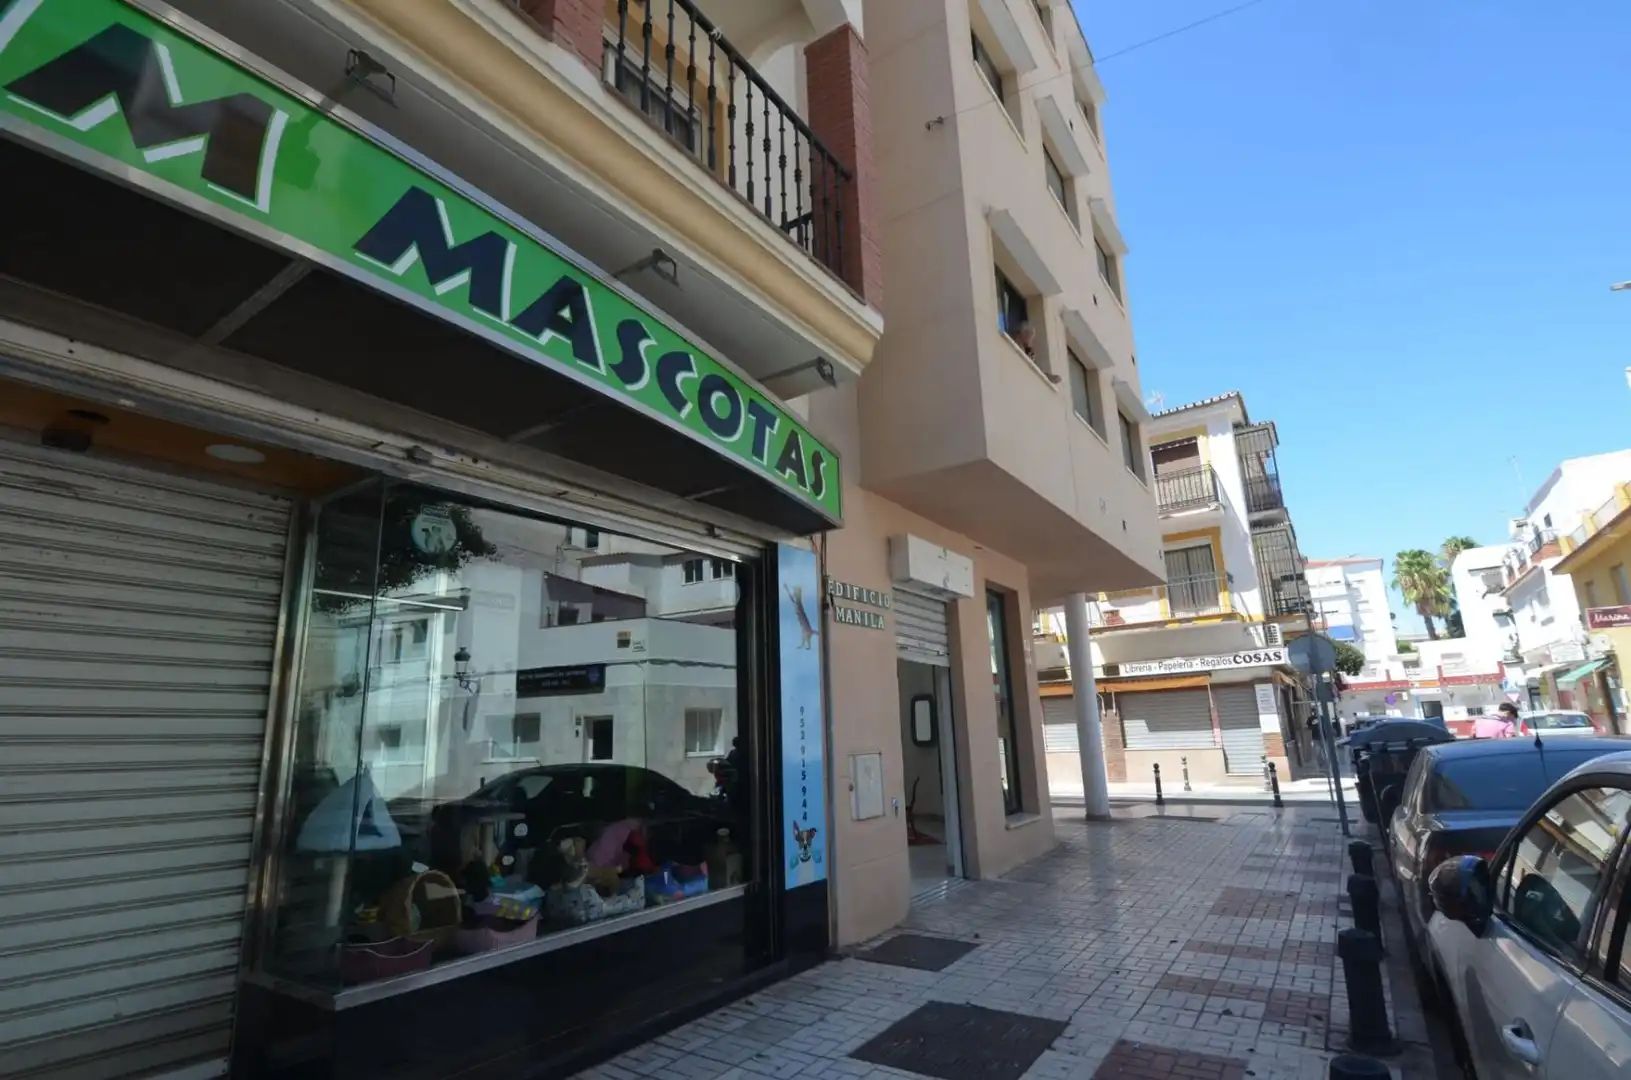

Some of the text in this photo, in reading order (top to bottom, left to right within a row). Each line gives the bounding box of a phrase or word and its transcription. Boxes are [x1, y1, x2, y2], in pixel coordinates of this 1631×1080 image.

[353, 185, 827, 500] MASCOTAS
[828, 580, 891, 608] EDIFICIO
[835, 606, 885, 629] MANILA
[1200, 657, 1232, 670] Regalos
[1233, 651, 1283, 665] COSAS
